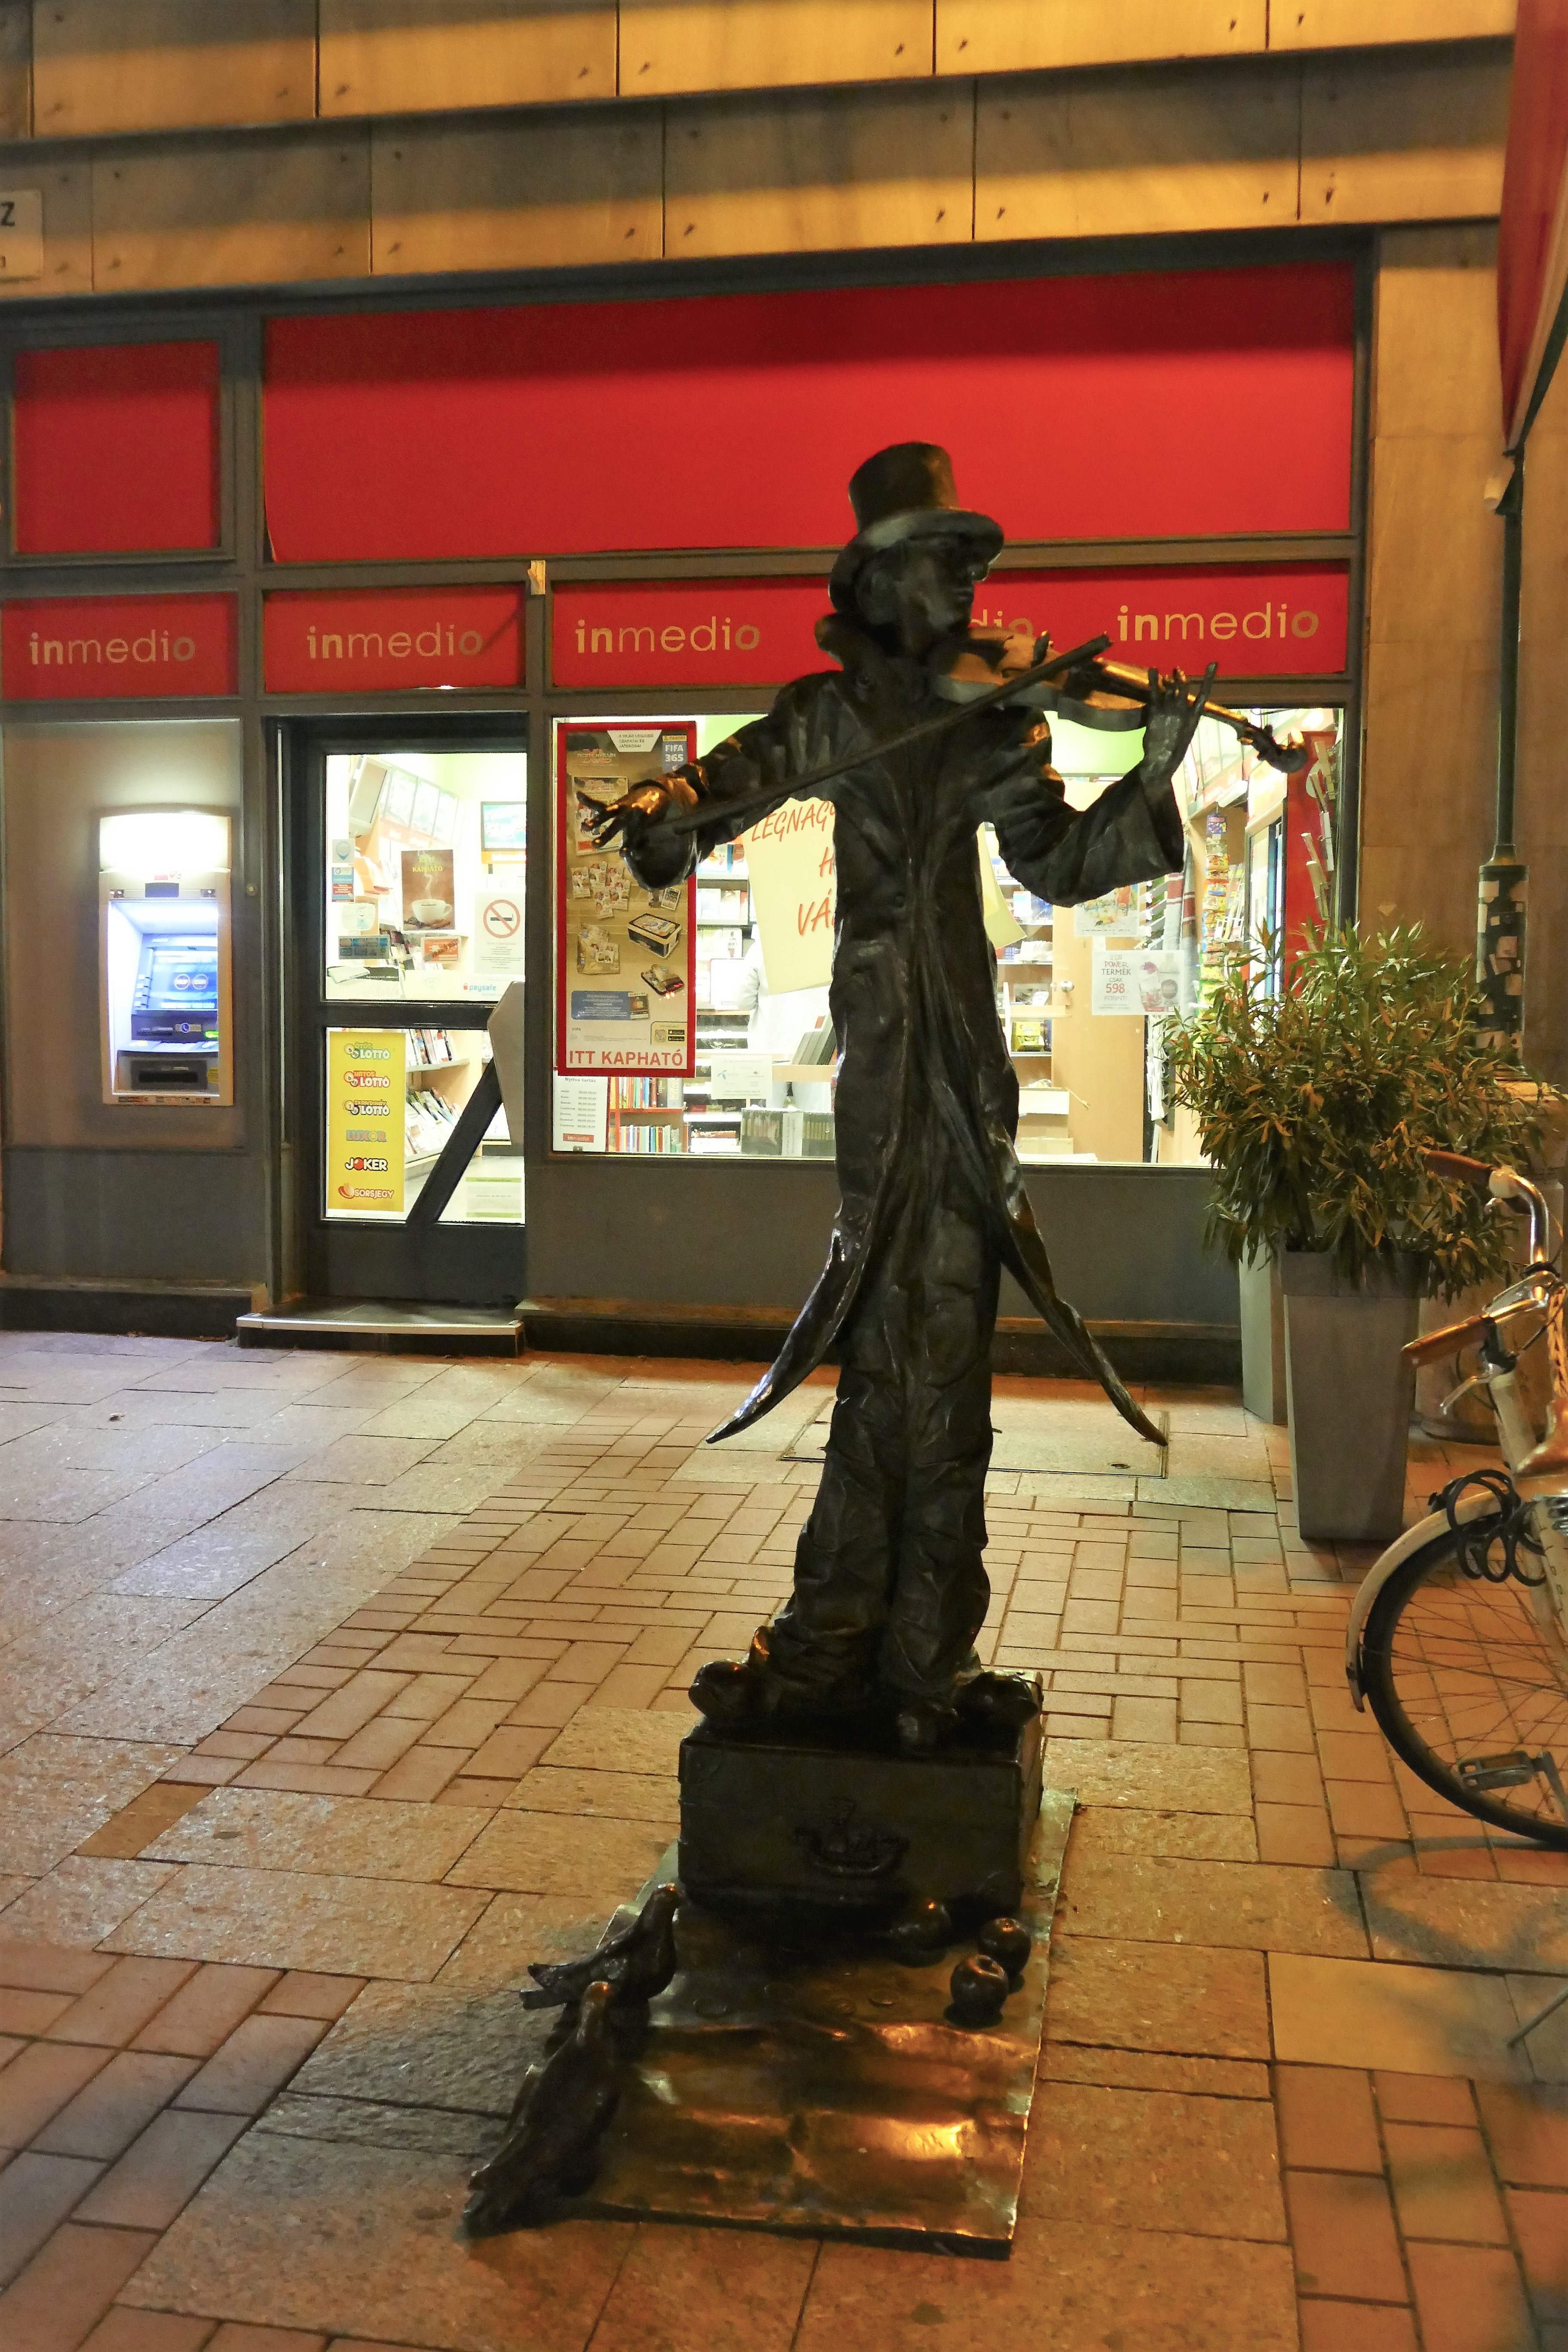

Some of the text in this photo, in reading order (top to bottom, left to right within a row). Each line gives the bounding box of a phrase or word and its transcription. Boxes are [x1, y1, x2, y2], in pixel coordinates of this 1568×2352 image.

[1117, 602, 1319, 641] inmedio
[576, 616, 760, 653] inmedio
[29, 629, 196, 665] inmedio
[306, 625, 483, 659] inmedio
[665, 753, 684, 763] 365
[798, 888, 835, 936] VÁ
[1101, 967, 1131, 975] TERMÉK
[469, 984, 496, 992] paysafe
[1106, 983, 1125, 993] 598
[360, 1048, 391, 1060] LOTTÓ
[570, 1048, 683, 1066] ITT KAPHATÓ
[360, 1075, 390, 1088] LOTTÓ
[361, 1105, 390, 1116] LOTTÓ
[346, 1130, 387, 1142] LUXOR
[354, 1188, 394, 1199] SORSJEGY
